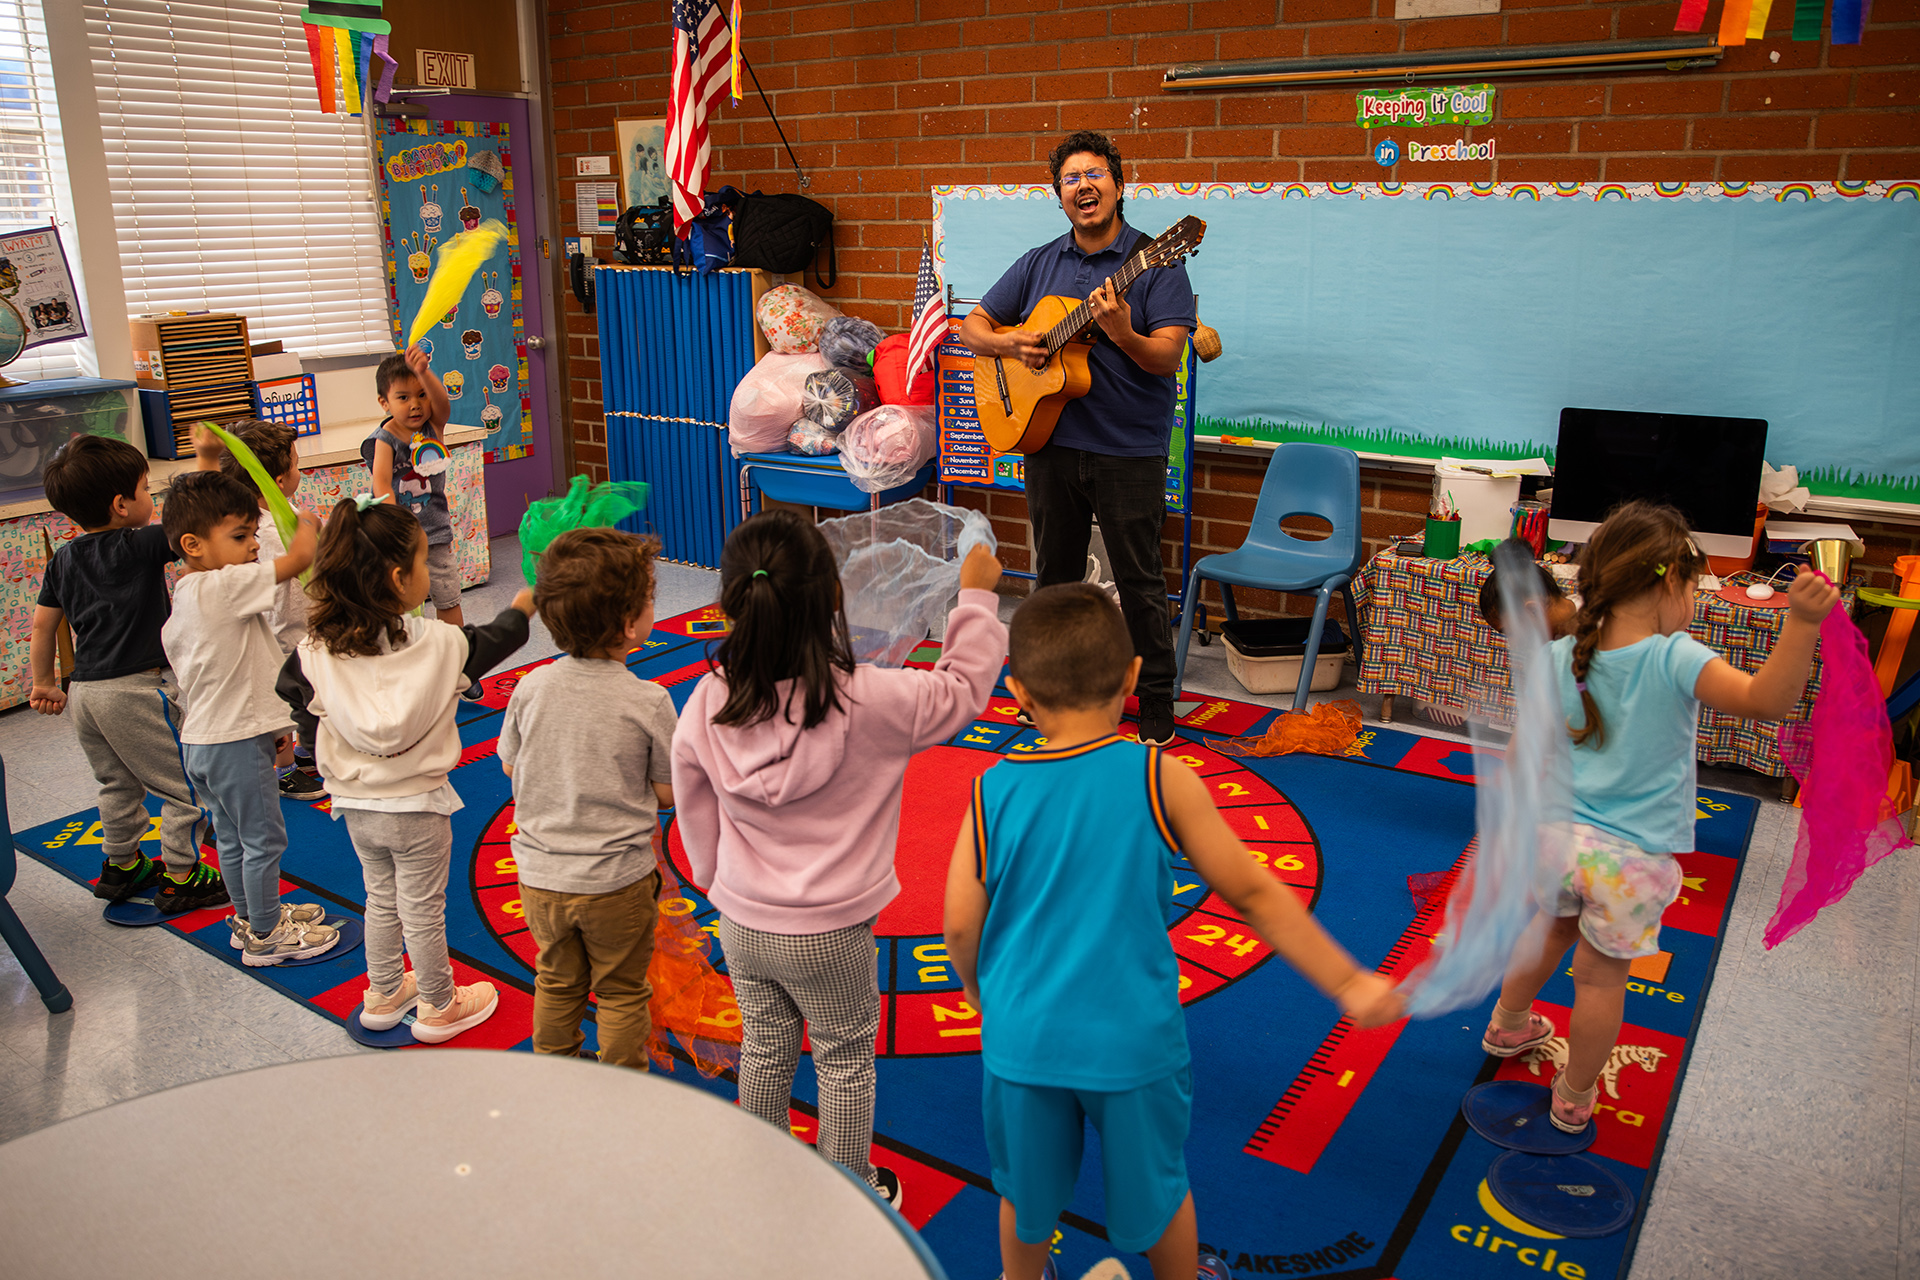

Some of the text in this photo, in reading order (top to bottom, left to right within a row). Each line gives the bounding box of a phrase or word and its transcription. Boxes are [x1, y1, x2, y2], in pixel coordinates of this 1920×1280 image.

[423, 51, 469, 87] EXIT
[1363, 92, 1487, 122] Keeping It Cool
[401, 143, 445, 165] HAPPY
[1380, 140, 1495, 161] in Preschool
[2, 235, 43, 252] WYATT
[958, 372, 974, 380] April
[960, 385, 974, 393] May
[958, 397, 975, 405] June
[960, 409, 974, 417] July
[955, 420, 979, 430] August
[950, 432, 985, 440] September
[953, 444, 981, 452] October
[950, 456, 981, 464] November
[949, 467, 981, 475] December
[992, 706, 1020, 716] 6
[1187, 701, 1230, 726] triangle
[962, 725, 1001, 744] Ff
[1176, 754, 1205, 768] 3
[1218, 782, 1250, 796] 2
[42, 821, 83, 849] stop
[1248, 850, 1305, 871] 26
[1184, 924, 1260, 957] 24
[912, 943, 951, 983] Uu
[931, 1001, 981, 1037] 21
[1218, 1231, 1375, 1274] LAKESHORE
[1451, 1224, 1587, 1280] circle
